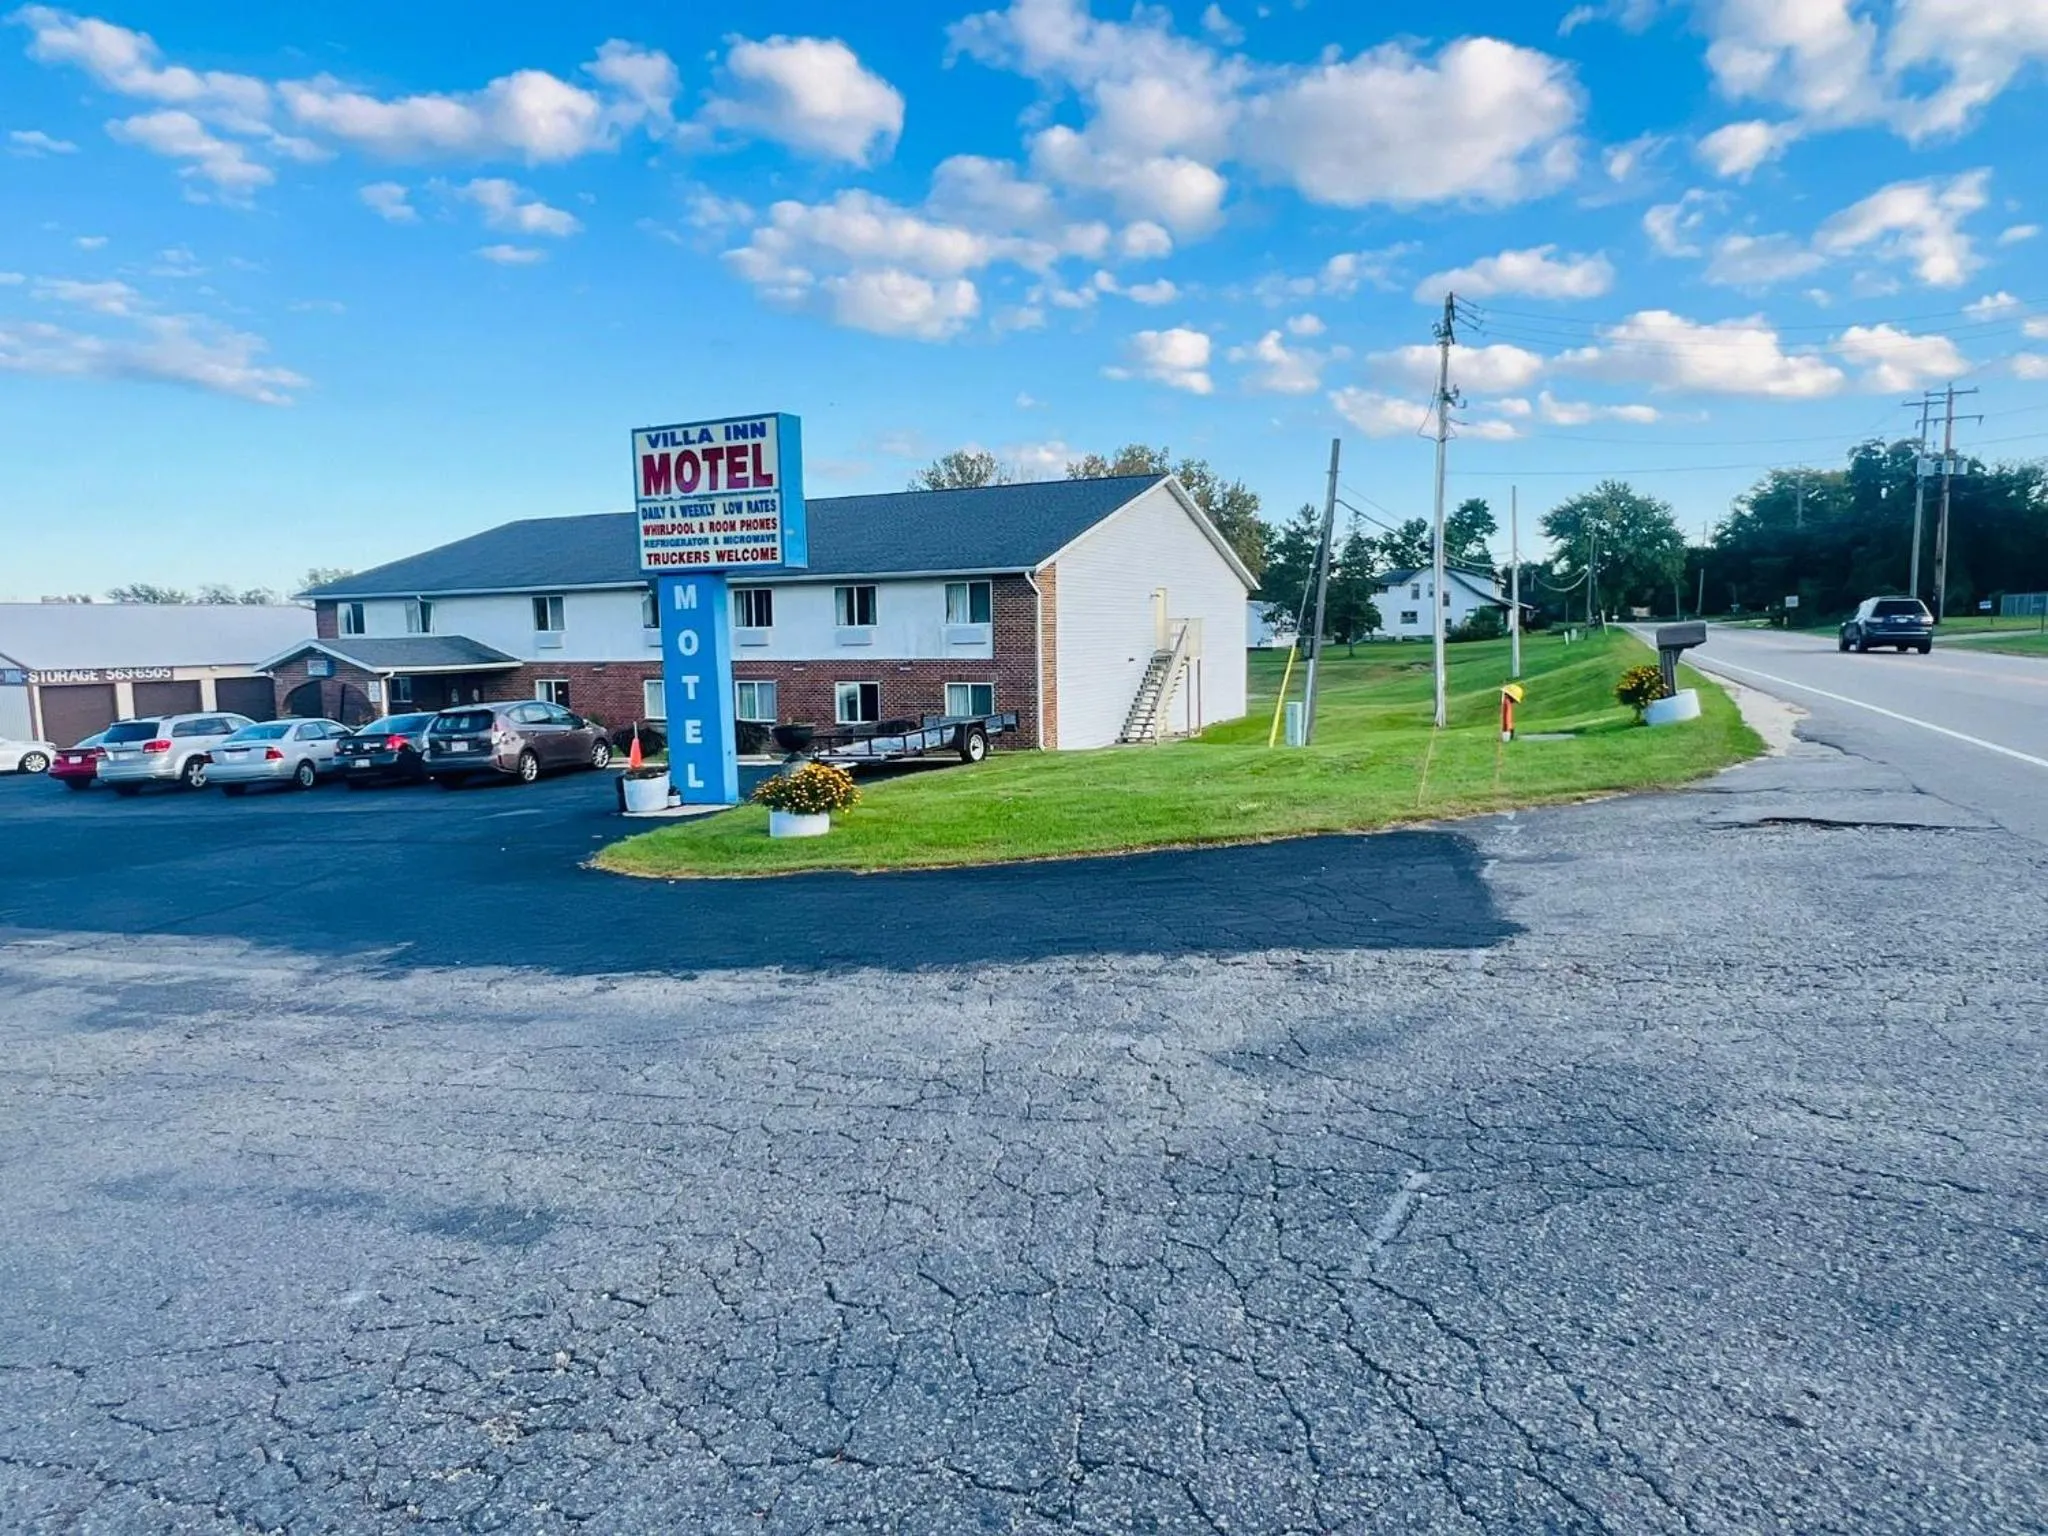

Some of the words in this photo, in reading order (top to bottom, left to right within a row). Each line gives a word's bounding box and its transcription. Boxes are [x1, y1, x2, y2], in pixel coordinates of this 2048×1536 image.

[646, 428, 714, 449] VILLA
[724, 422, 767, 441] INN
[642, 443, 774, 497] MOTEL
[641, 506, 666, 520] DAILY
[669, 505, 677, 518] &
[680, 503, 716, 518] WEEKLY
[723, 501, 744, 515] LOW
[747, 499, 777, 514] RATES
[643, 522, 696, 536] WHIRLPOOL
[699, 522, 704, 533] &
[709, 520, 737, 533] ROOM
[740, 518, 778, 532] PHONES
[644, 537, 710, 548] REFRIGERATOR
[713, 536, 719, 546] &
[723, 533, 777, 545] MICROWAVE
[646, 550, 710, 566] TRUCKERS
[715, 547, 778, 562] WELCOME
[28, 670, 99, 684] STORAGE
